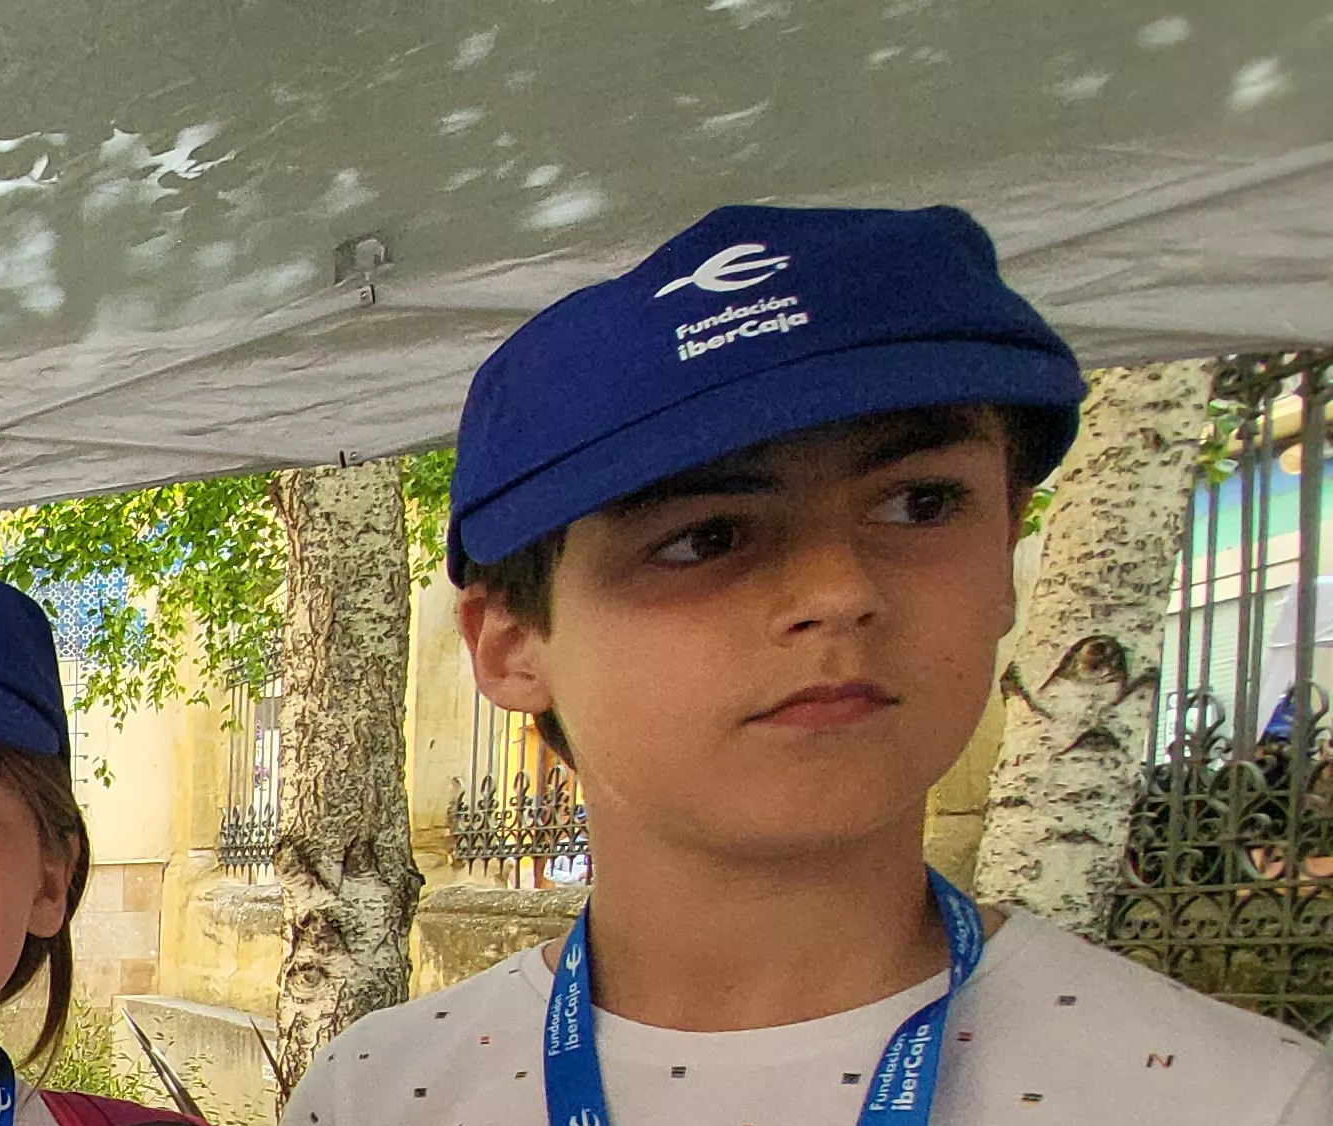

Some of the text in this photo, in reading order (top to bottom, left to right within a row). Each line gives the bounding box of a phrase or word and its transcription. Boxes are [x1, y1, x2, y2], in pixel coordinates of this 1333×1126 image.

[675, 296, 799, 340] Fundación
[677, 312, 809, 361] iberCaja
[548, 993, 563, 1057] Fundación
[564, 981, 582, 1052] iberCaja
[869, 1031, 909, 1112] Fundación
[891, 1024, 933, 1111] iberCaja
